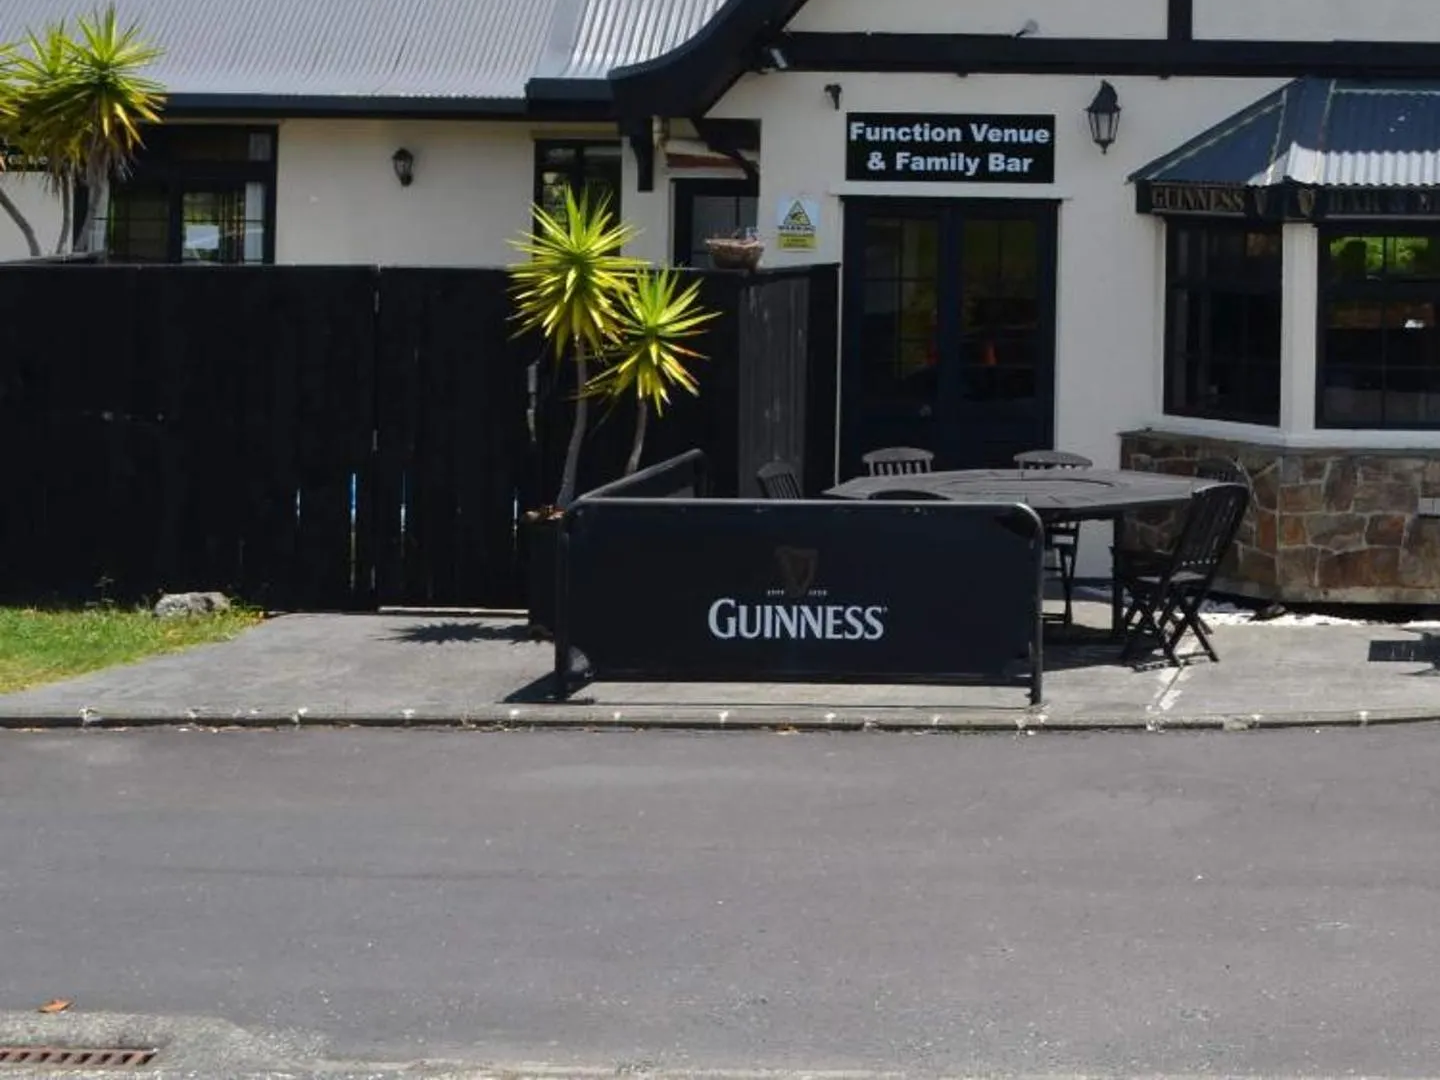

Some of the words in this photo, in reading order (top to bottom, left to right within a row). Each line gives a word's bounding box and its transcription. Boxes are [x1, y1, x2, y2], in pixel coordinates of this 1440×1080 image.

[850, 122, 962, 142] Function
[969, 123, 1050, 143] Venue
[867, 151, 886, 170] &
[896, 152, 980, 176] Family
[988, 153, 1034, 172] Bar
[1152, 186, 1246, 212] GUINNESS
[708, 598, 885, 640] GUINNESS
